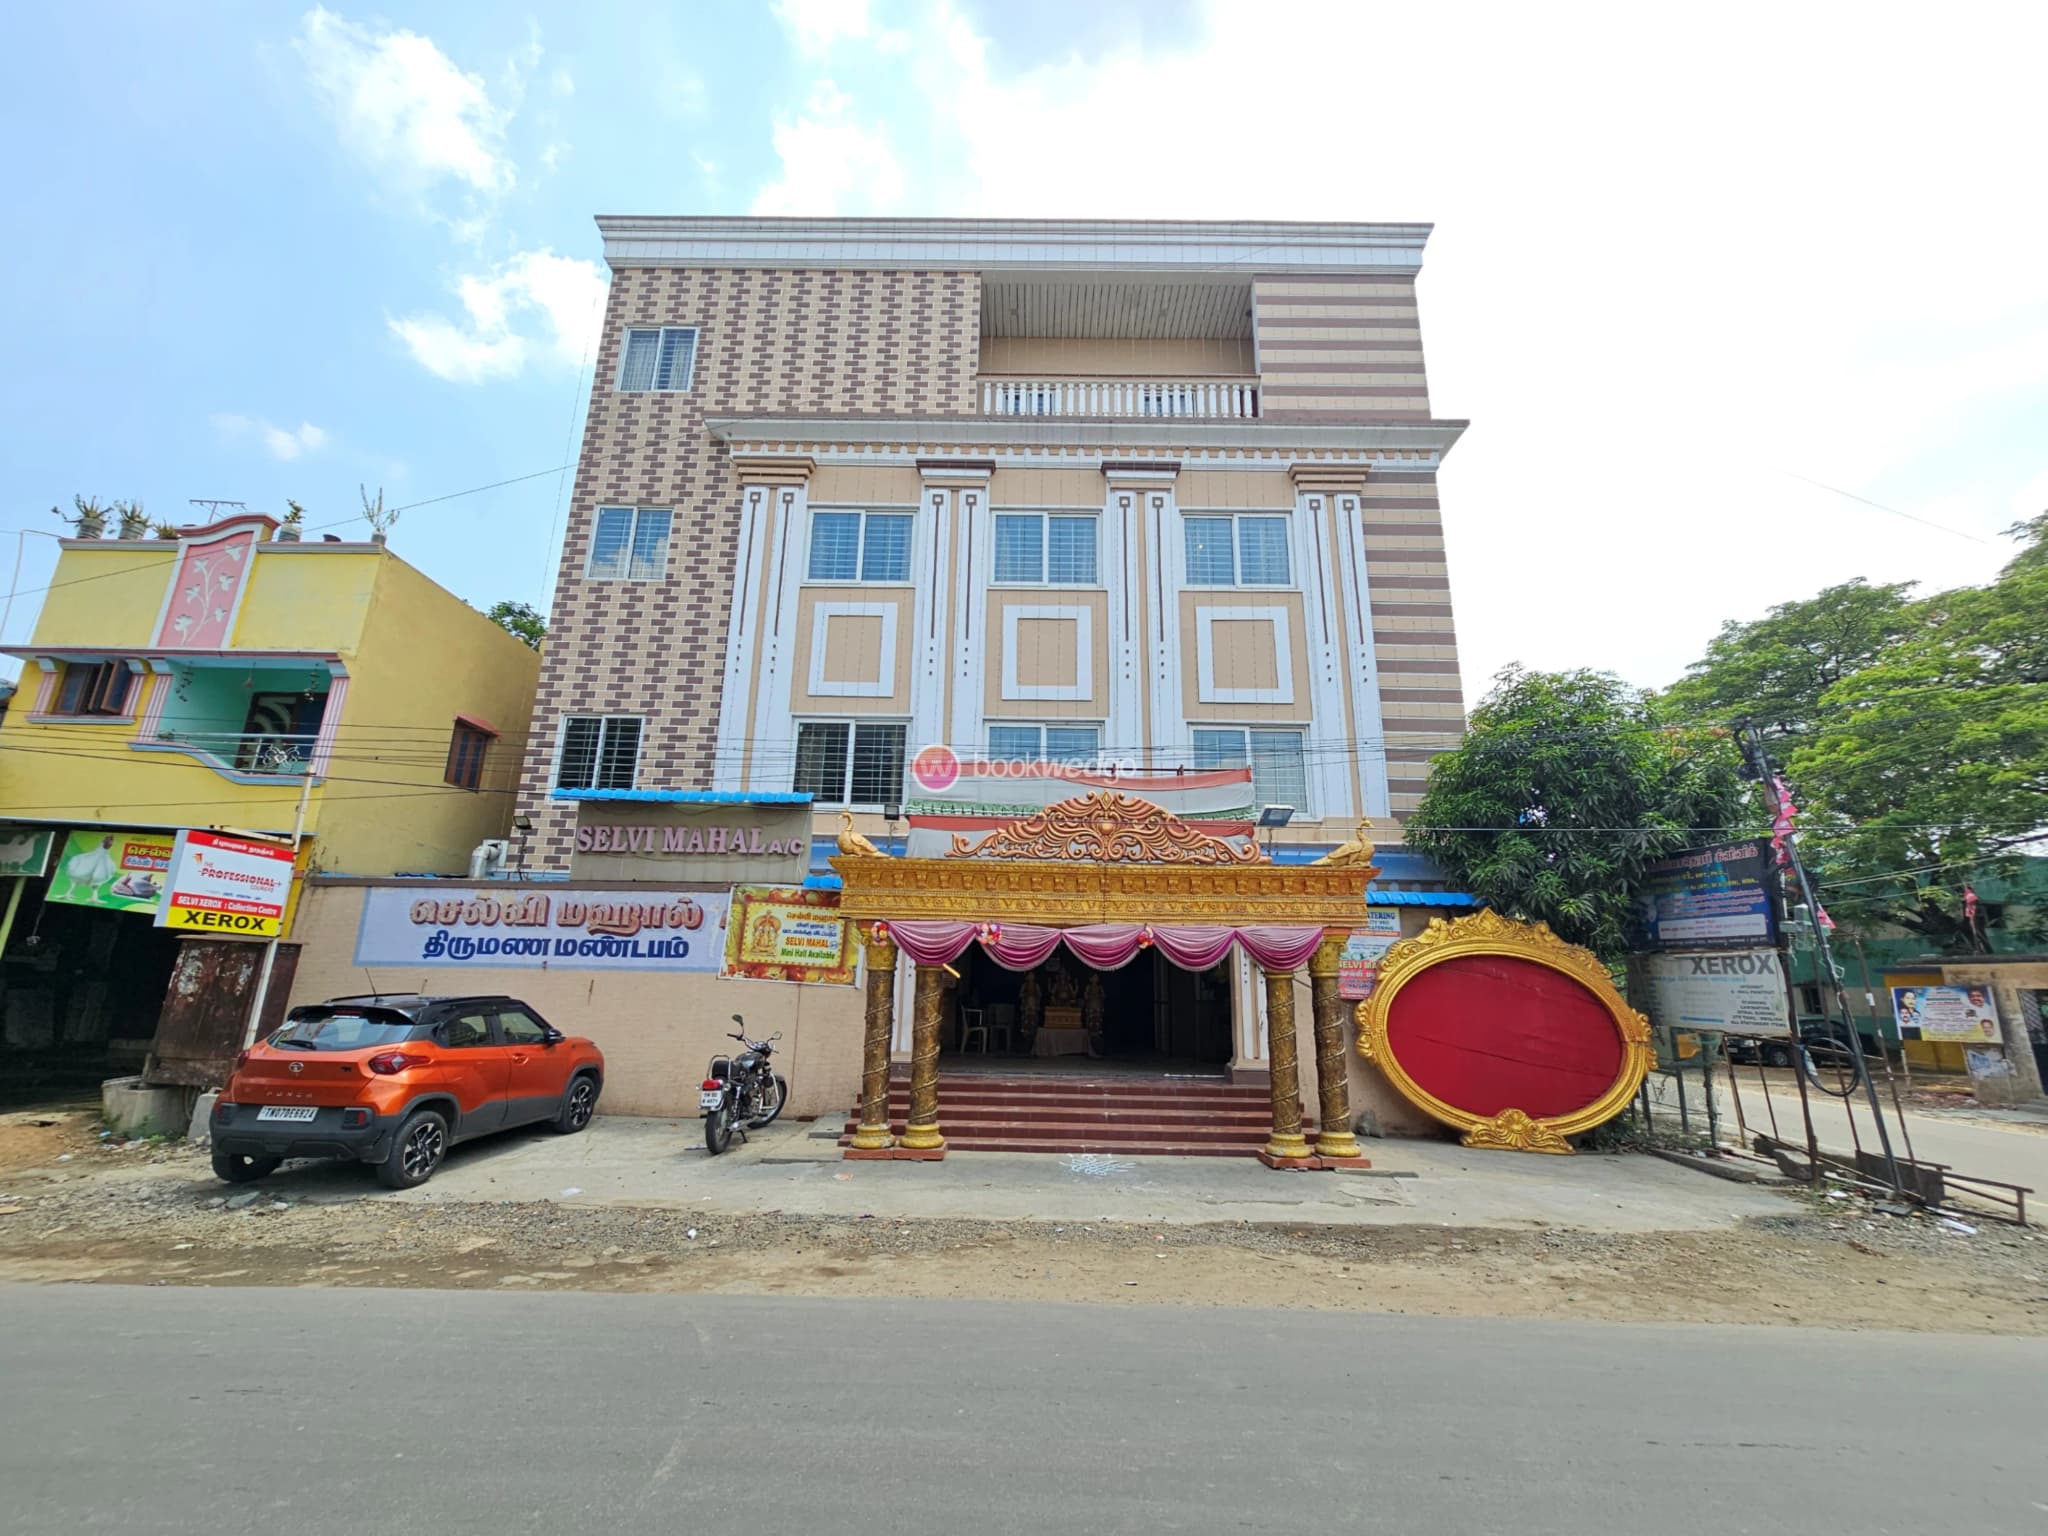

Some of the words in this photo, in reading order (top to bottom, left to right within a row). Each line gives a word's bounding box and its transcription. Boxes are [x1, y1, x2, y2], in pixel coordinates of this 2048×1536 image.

[577, 825, 656, 853] SELVI
[661, 826, 764, 854] MAHAL
[768, 838, 804, 855] A/C
[200, 867, 275, 888] PROFESSIONAL
[177, 896, 199, 906] SELVI
[199, 898, 222, 909] XEROX
[183, 910, 266, 931] XEROX
[410, 894, 550, 926] செல்வி
[555, 897, 704, 937] மஹால்
[423, 930, 549, 960] திருமண
[554, 935, 690, 959] மண்டபம்
[785, 937, 806, 946] SELVI
[806, 938, 829, 948] MAHAL
[808, 950, 836, 960] Available
[1691, 954, 1775, 975] XEROX
